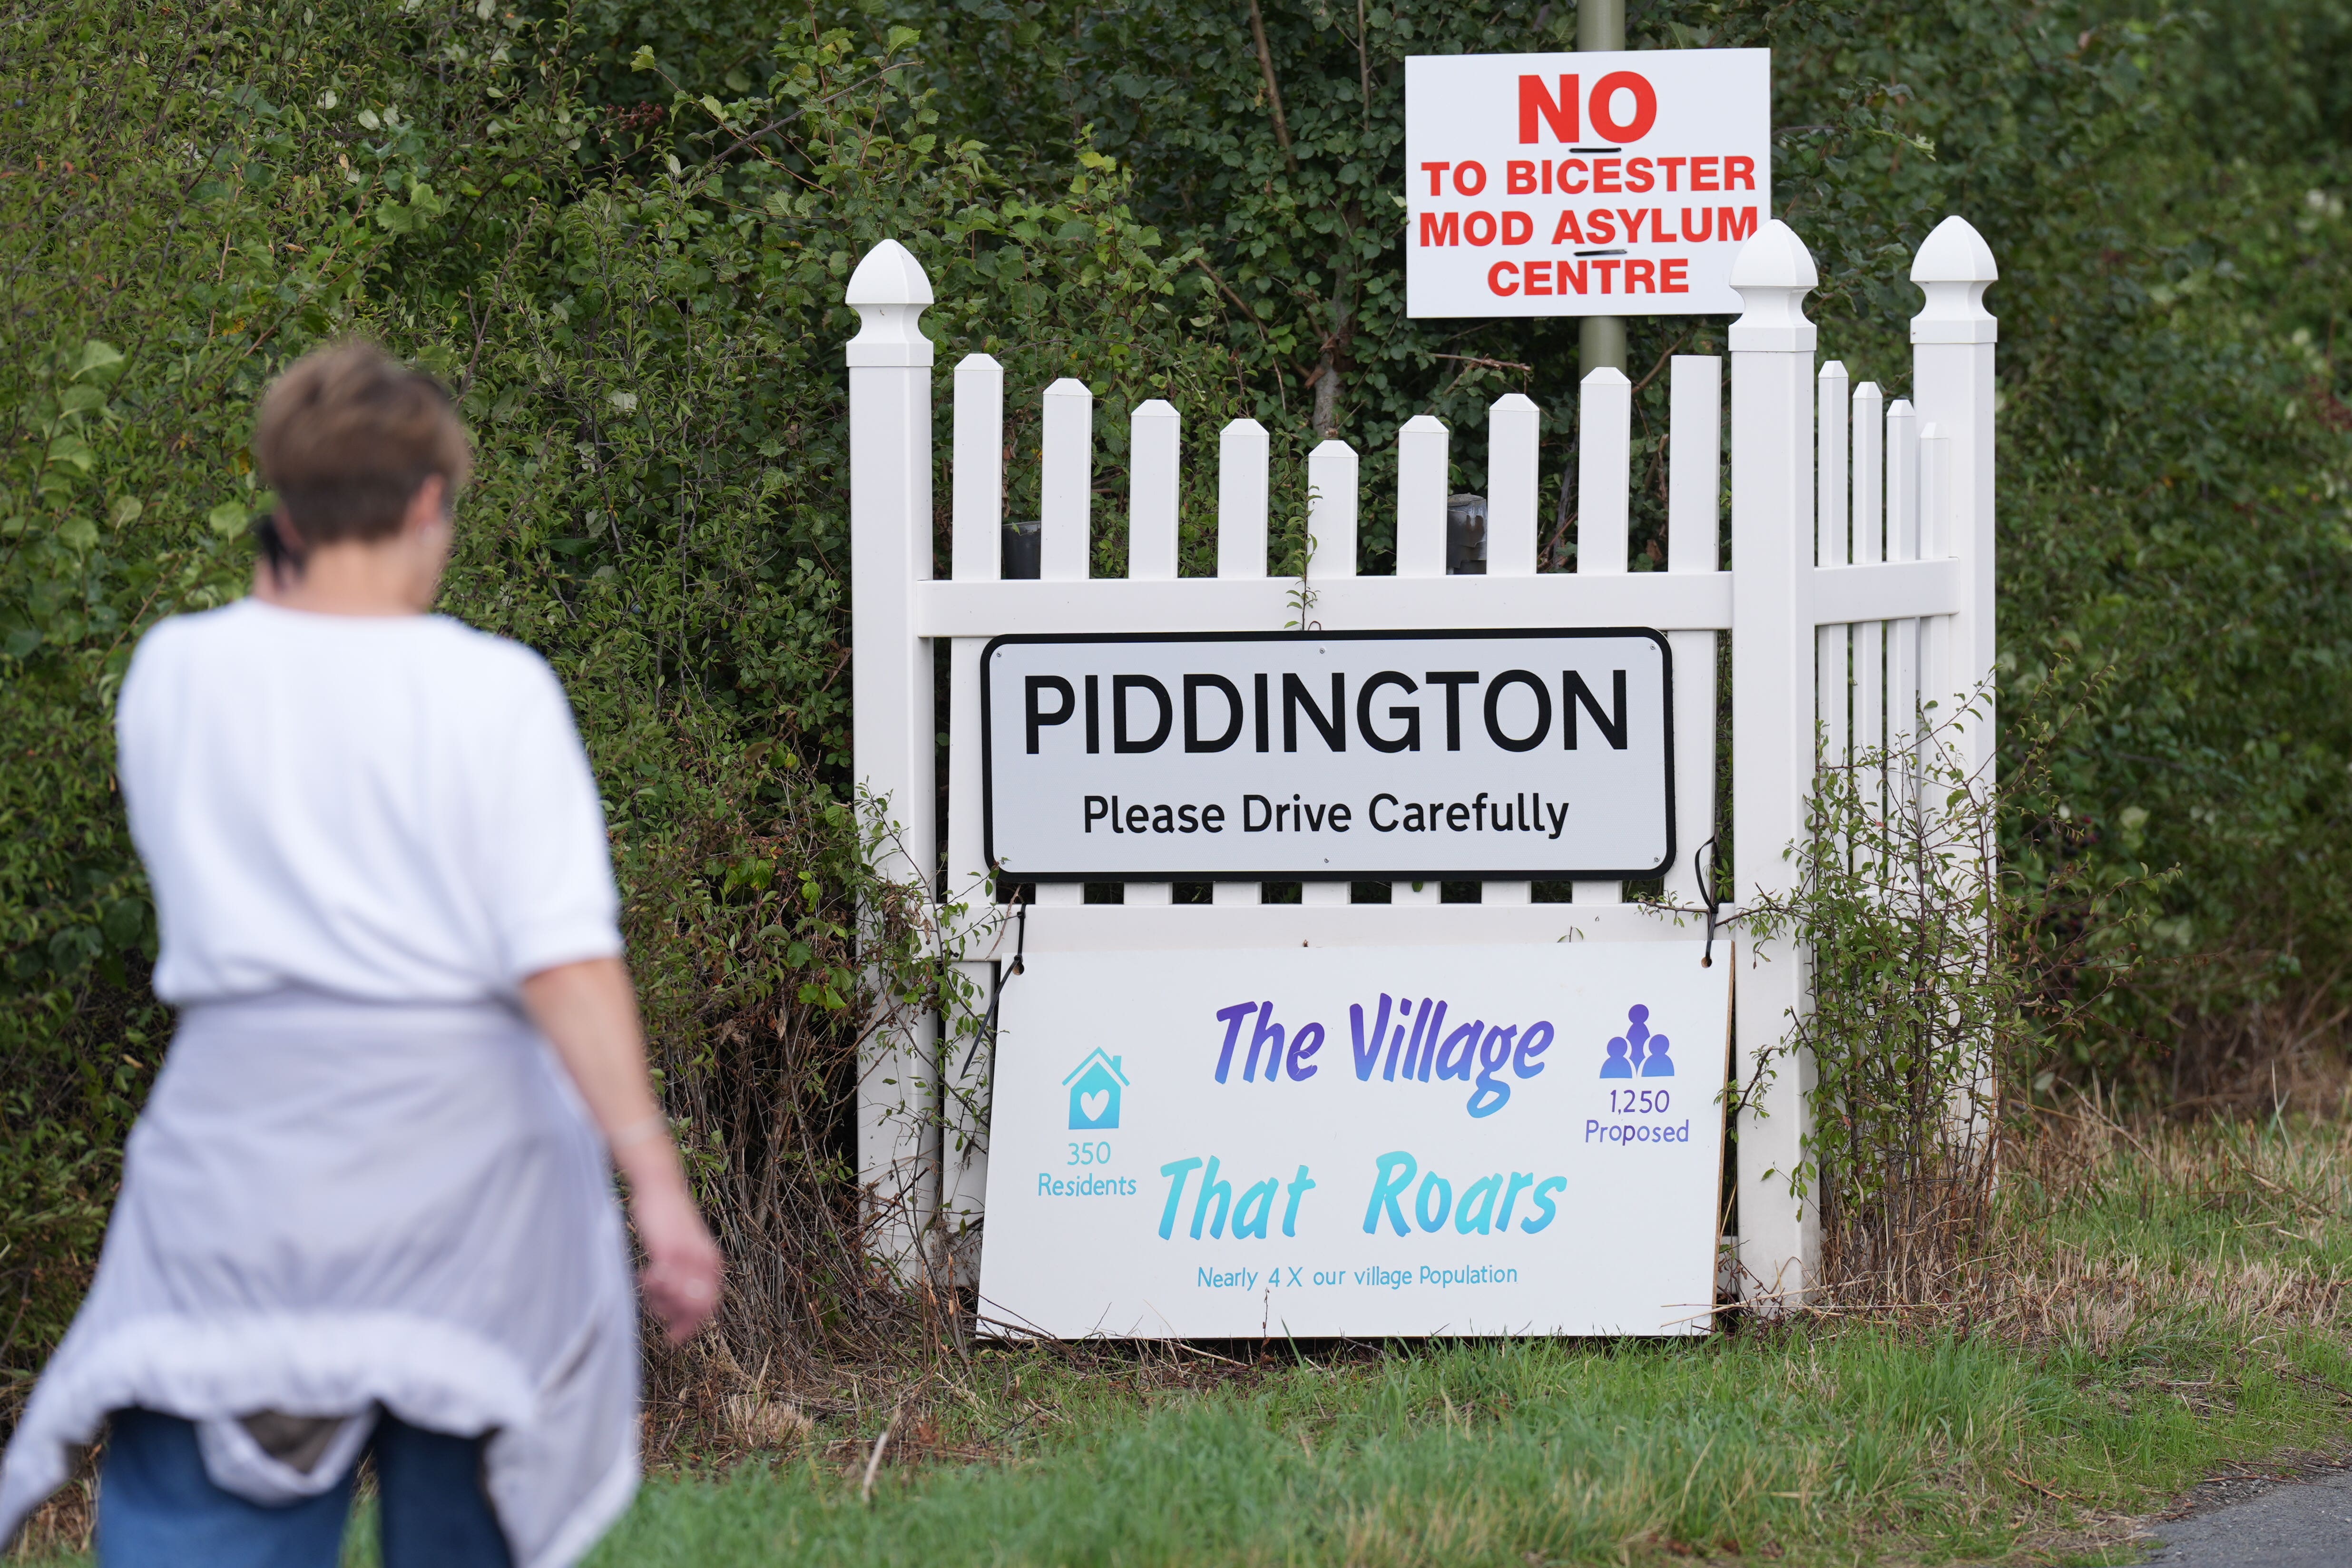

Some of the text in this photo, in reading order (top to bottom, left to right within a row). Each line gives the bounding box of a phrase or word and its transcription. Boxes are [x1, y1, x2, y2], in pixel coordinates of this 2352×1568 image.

[1519, 71, 1657, 144] NO
[1421, 156, 1755, 196] TO BICESTER
[1420, 206, 1757, 247] MOD ASYLUM
[1488, 258, 1689, 296] CENTRE
[1025, 670, 1627, 754] PIDDINGTON
[1085, 793, 1568, 839] Please Drive Carefully
[1215, 993, 1554, 1118] The Village
[1610, 1090, 1670, 1115] 1,250
[1586, 1120, 1688, 1145] Proposed
[1068, 1142, 1110, 1165] 350
[1039, 1173, 1136, 1196] Residents
[1158, 1151, 1567, 1240] That Roars
[1198, 1265, 1517, 1291] Nearly 4 X our village Population
